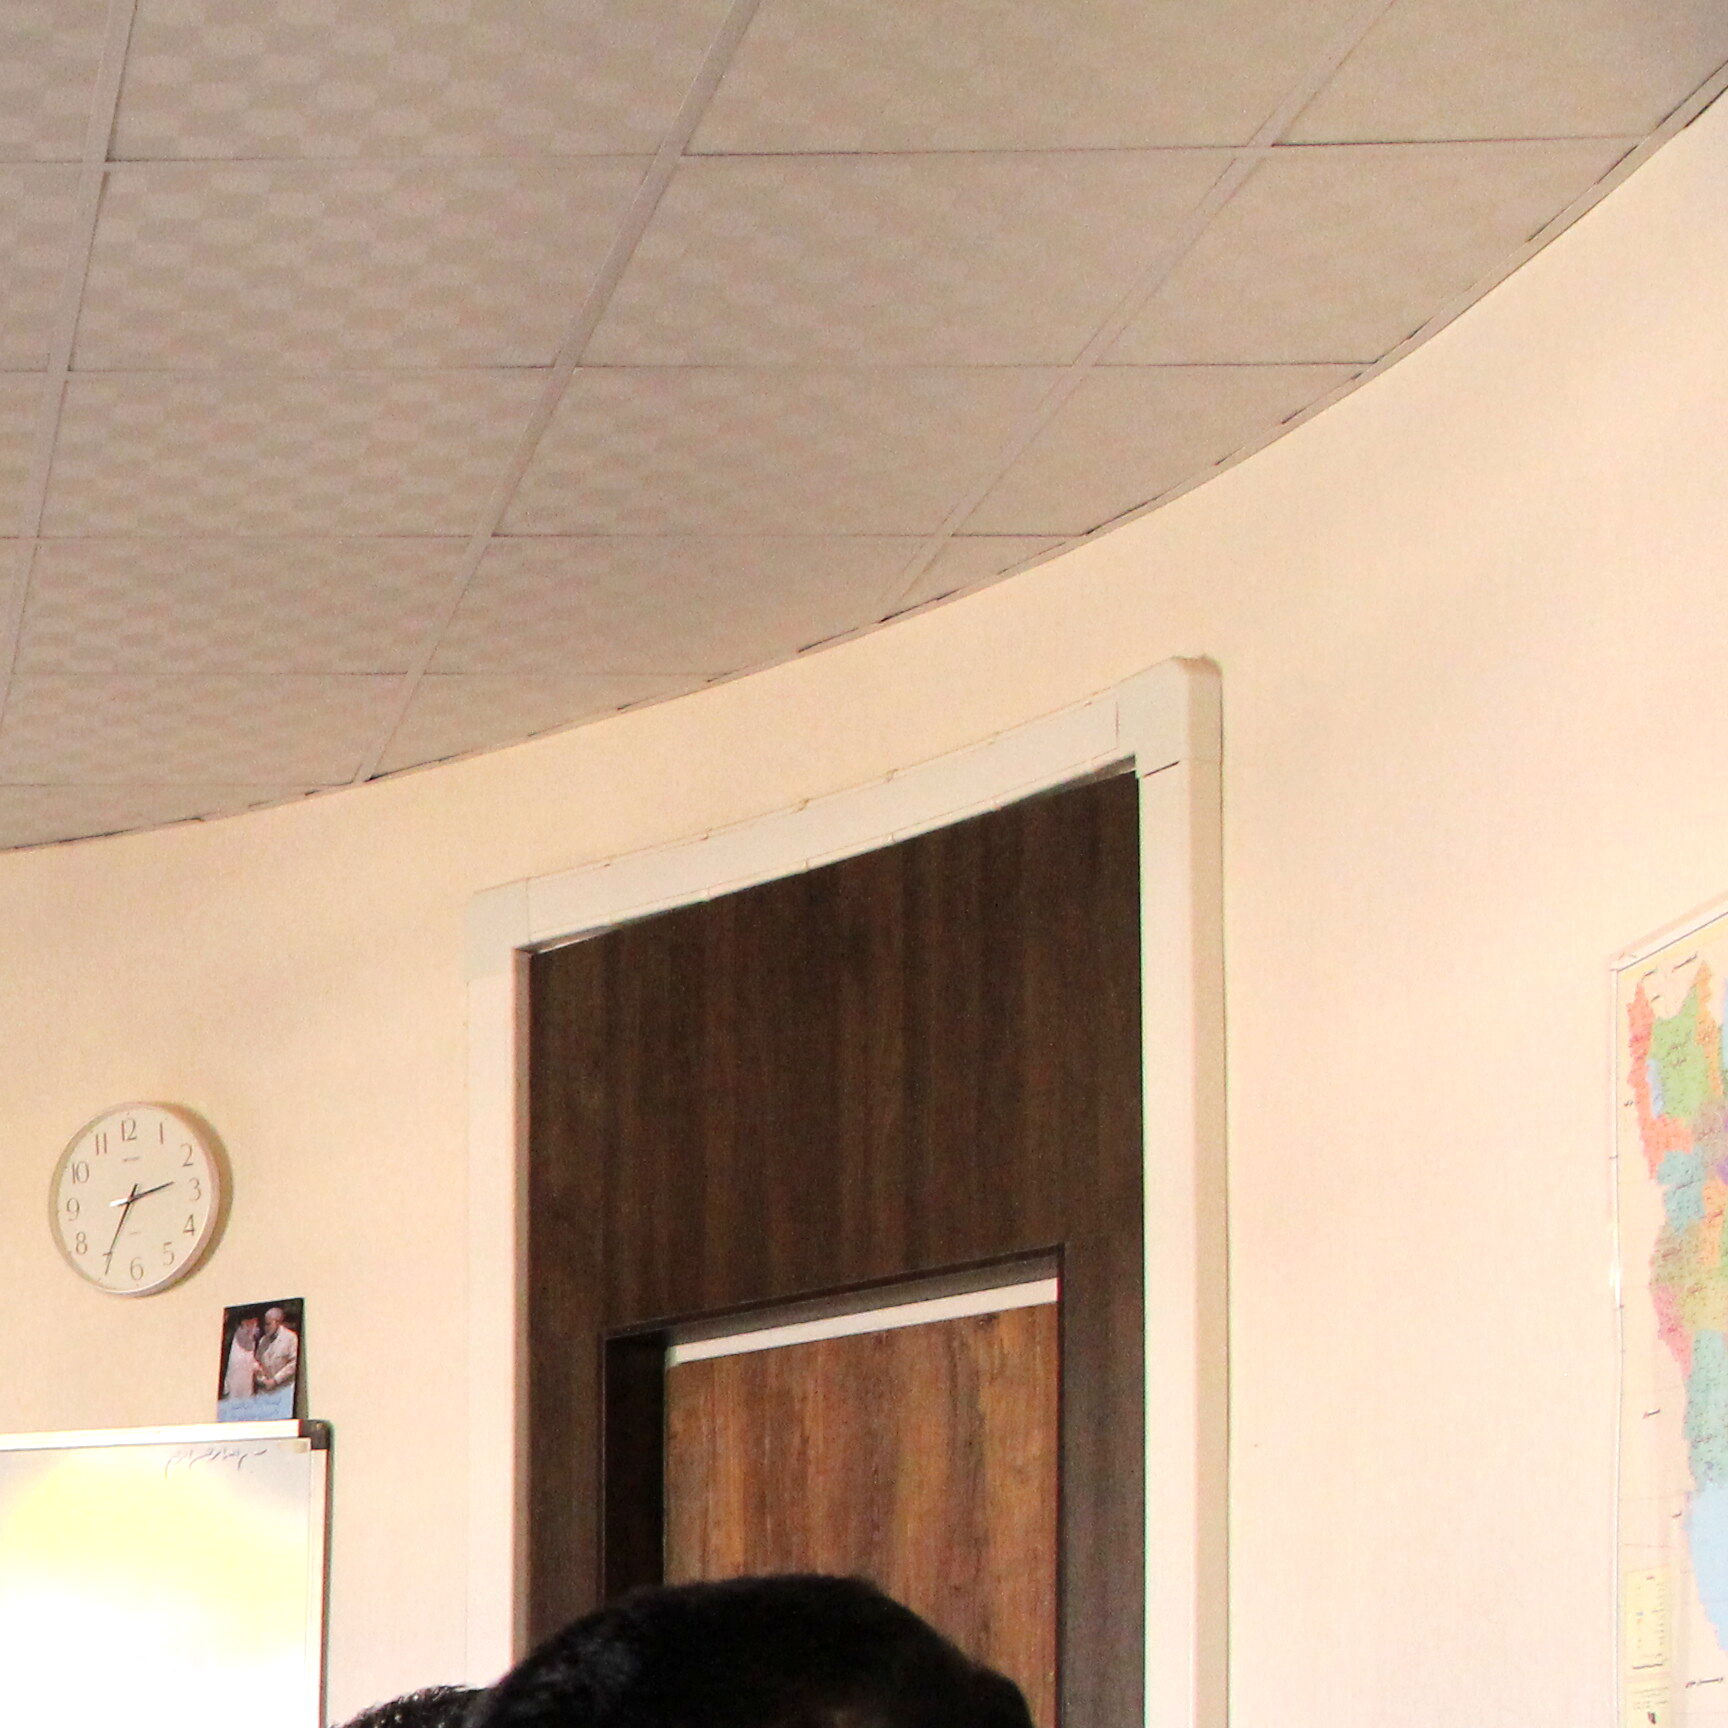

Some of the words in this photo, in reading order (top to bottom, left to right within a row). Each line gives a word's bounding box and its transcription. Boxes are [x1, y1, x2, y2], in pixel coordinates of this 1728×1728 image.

[120, 1118, 138, 1142] 12
[95, 1133, 108, 1155] 11
[180, 1143, 194, 1167] 2
[71, 1161, 90, 1185] 10
[188, 1177, 202, 1201] 3
[66, 1198, 81, 1222] 9
[183, 1213, 195, 1236] 4
[75, 1231, 88, 1255] 8
[162, 1242, 175, 1266] 5
[130, 1256, 144, 1280] 6
